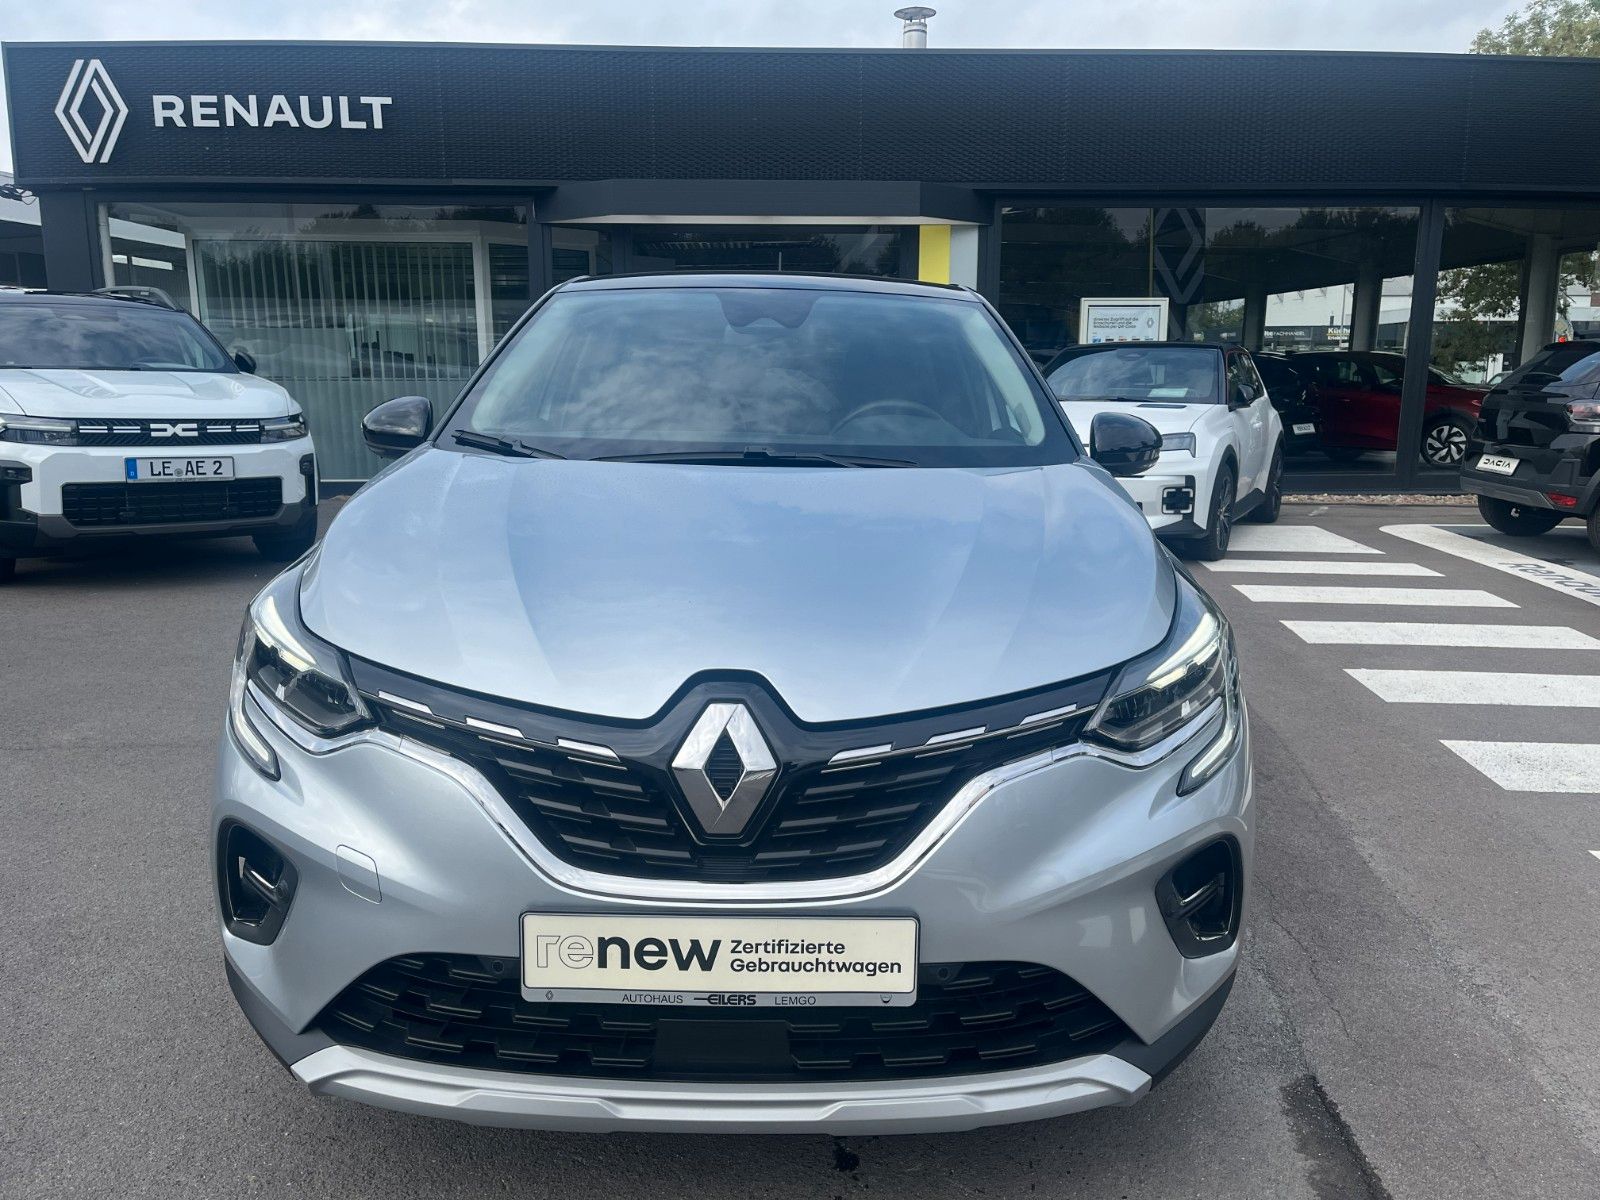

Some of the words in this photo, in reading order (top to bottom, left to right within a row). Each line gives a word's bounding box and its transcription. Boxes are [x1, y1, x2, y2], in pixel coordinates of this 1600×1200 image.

[152, 94, 393, 130] RENAULT
[150, 461, 174, 477] LE
[185, 460, 207, 476] AE
[213, 460, 223, 475] 2
[1483, 458, 1512, 468] DACIA
[536, 934, 722, 972] renew
[730, 939, 846, 955] Zertifizierte
[730, 958, 902, 977] Gebrauchtwagen
[622, 993, 684, 1004] AUTOHAUS
[706, 994, 757, 1006] EILERS
[774, 996, 817, 1006] LEMGO
